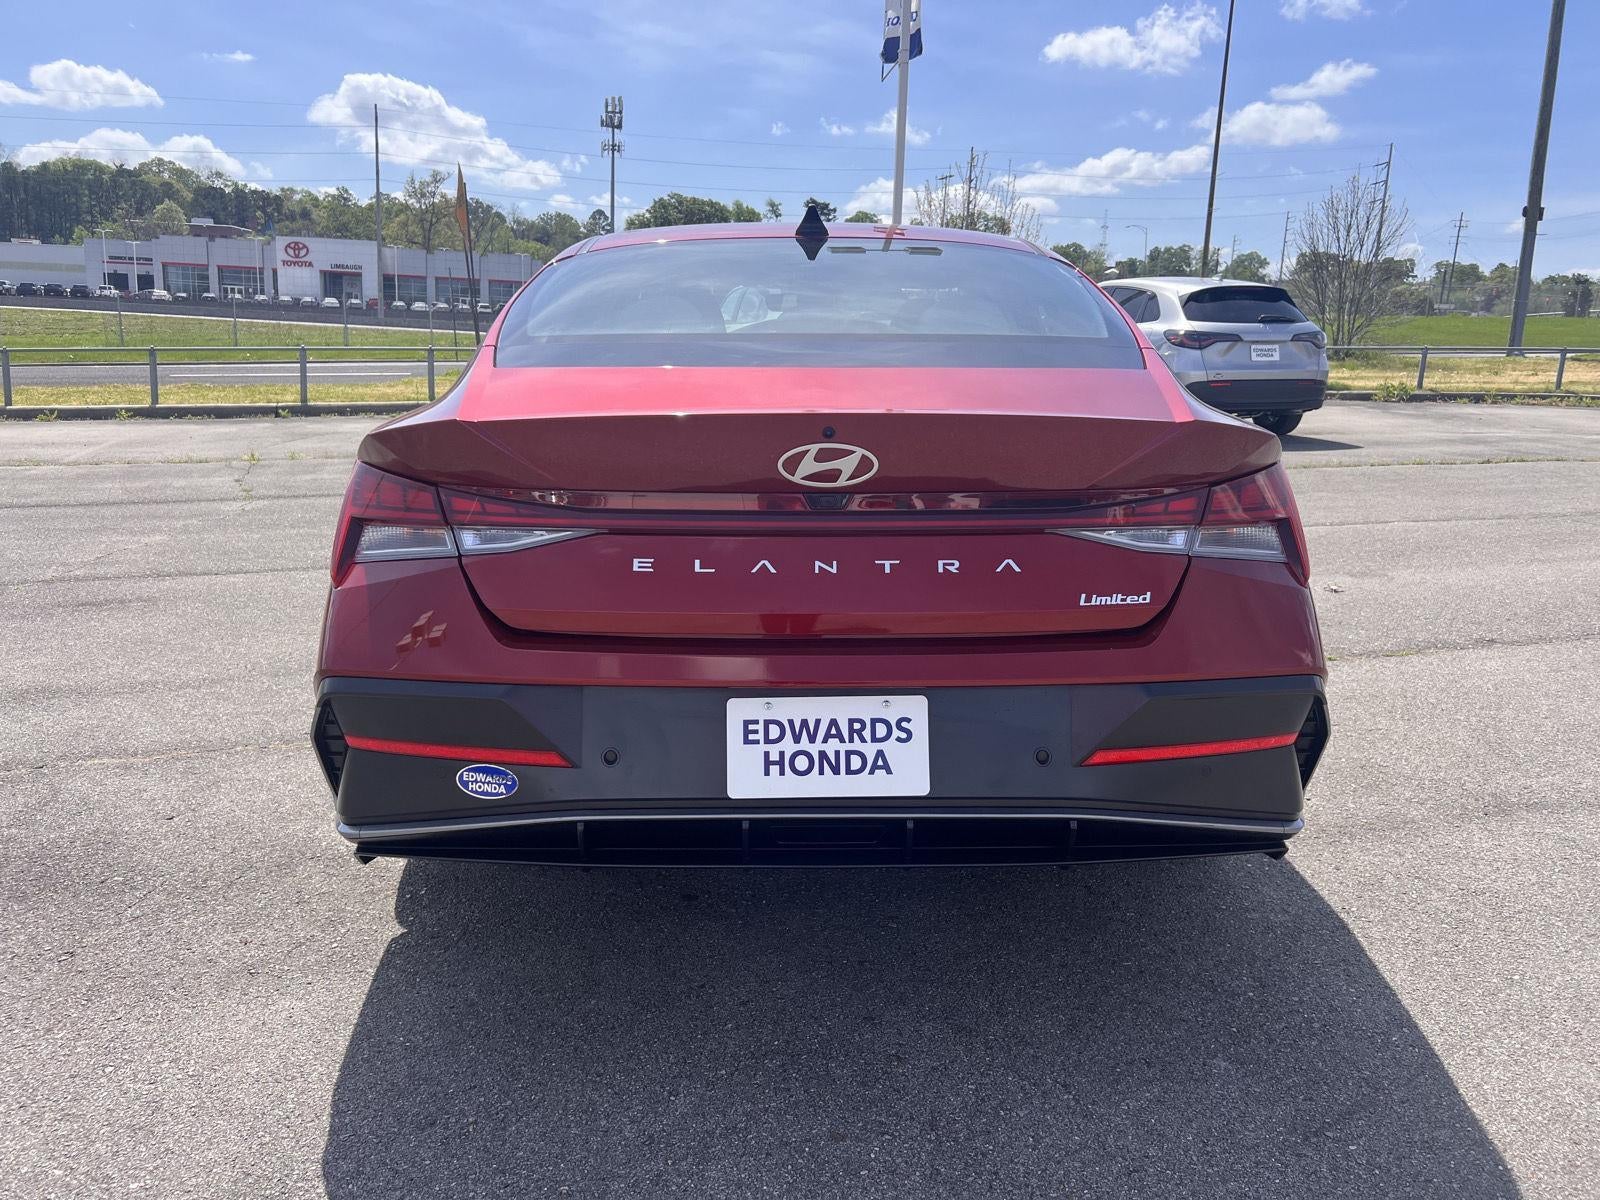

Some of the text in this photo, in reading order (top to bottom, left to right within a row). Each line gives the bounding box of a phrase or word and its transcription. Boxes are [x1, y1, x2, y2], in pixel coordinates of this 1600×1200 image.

[281, 260, 314, 268] TOYOTA
[330, 263, 363, 271] LIMBAUGH
[632, 557, 1022, 574] ELANTRA
[1079, 591, 1152, 606] Limited
[742, 716, 914, 745] EDWARDS
[763, 749, 894, 777] HONDA
[463, 771, 513, 785] EDWARDS
[468, 782, 507, 794] HONDA
